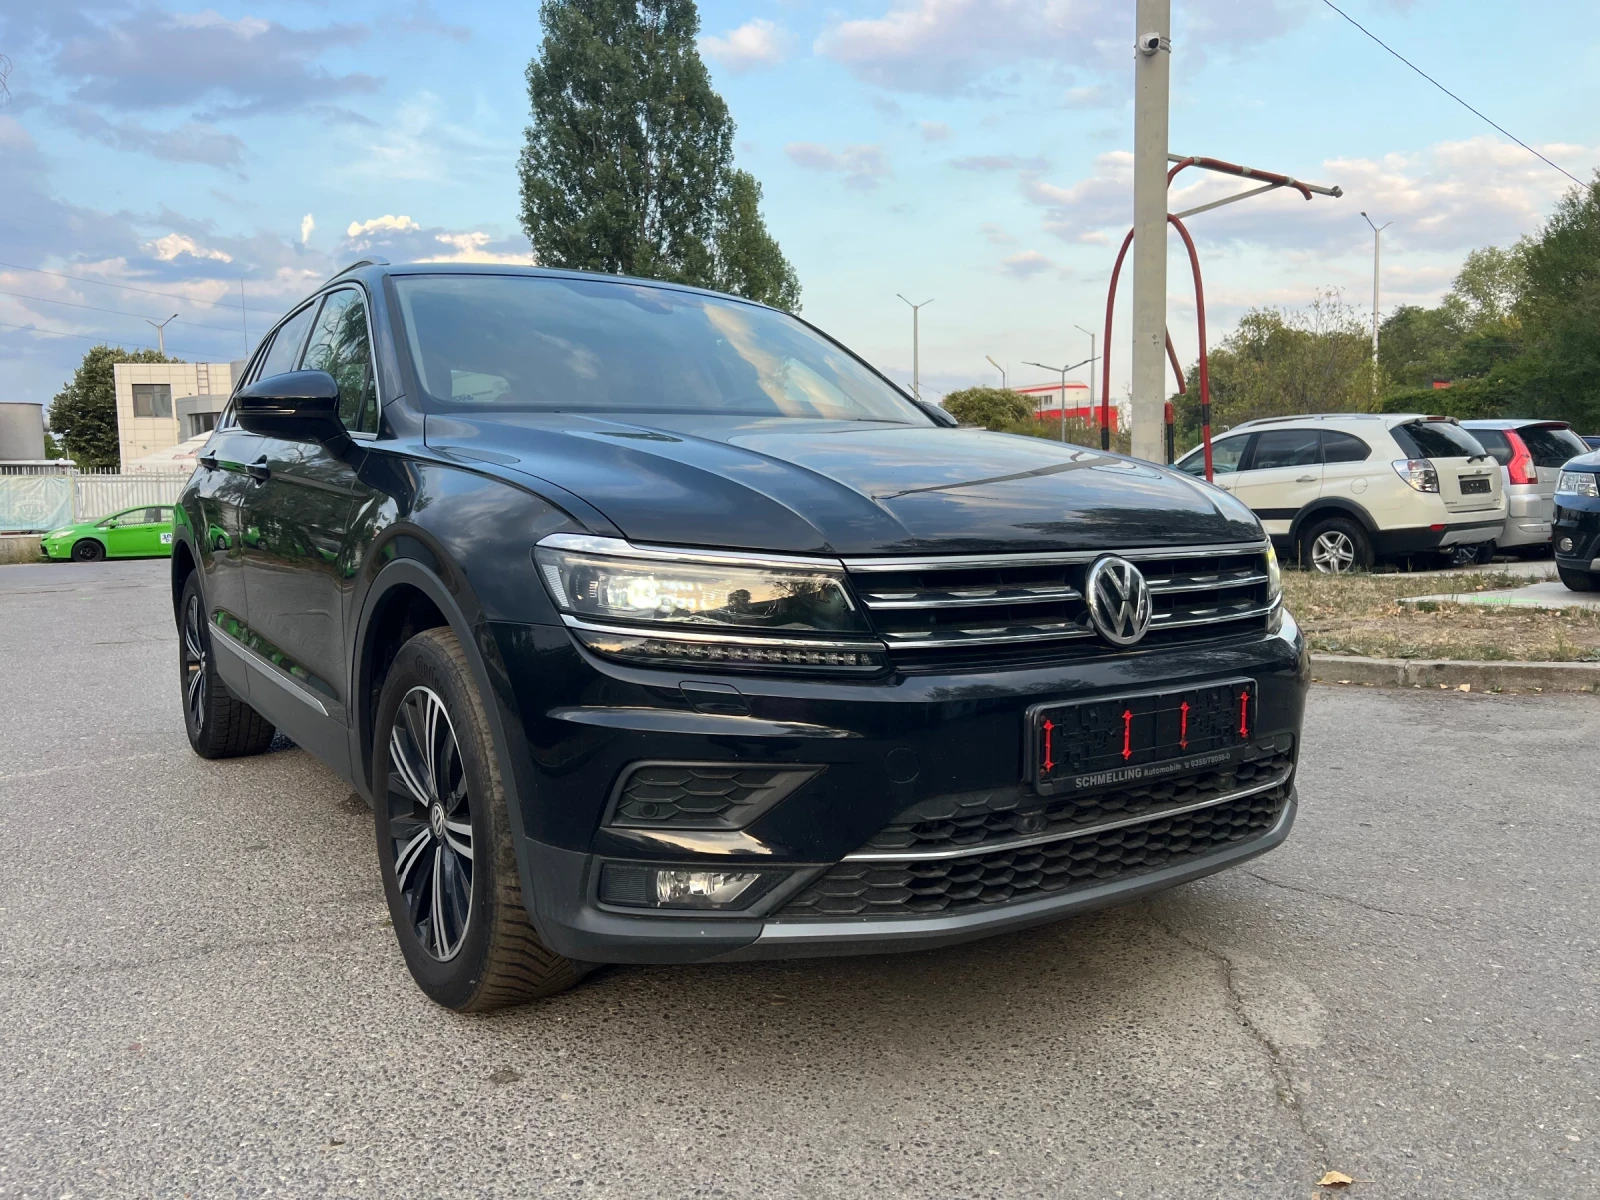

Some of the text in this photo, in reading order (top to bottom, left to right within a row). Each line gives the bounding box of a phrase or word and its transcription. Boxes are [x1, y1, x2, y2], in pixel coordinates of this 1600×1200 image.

[1087, 558, 1151, 644] VW
[1075, 768, 1142, 789] SCHMELLING
[1144, 764, 1182, 777] Automobile
